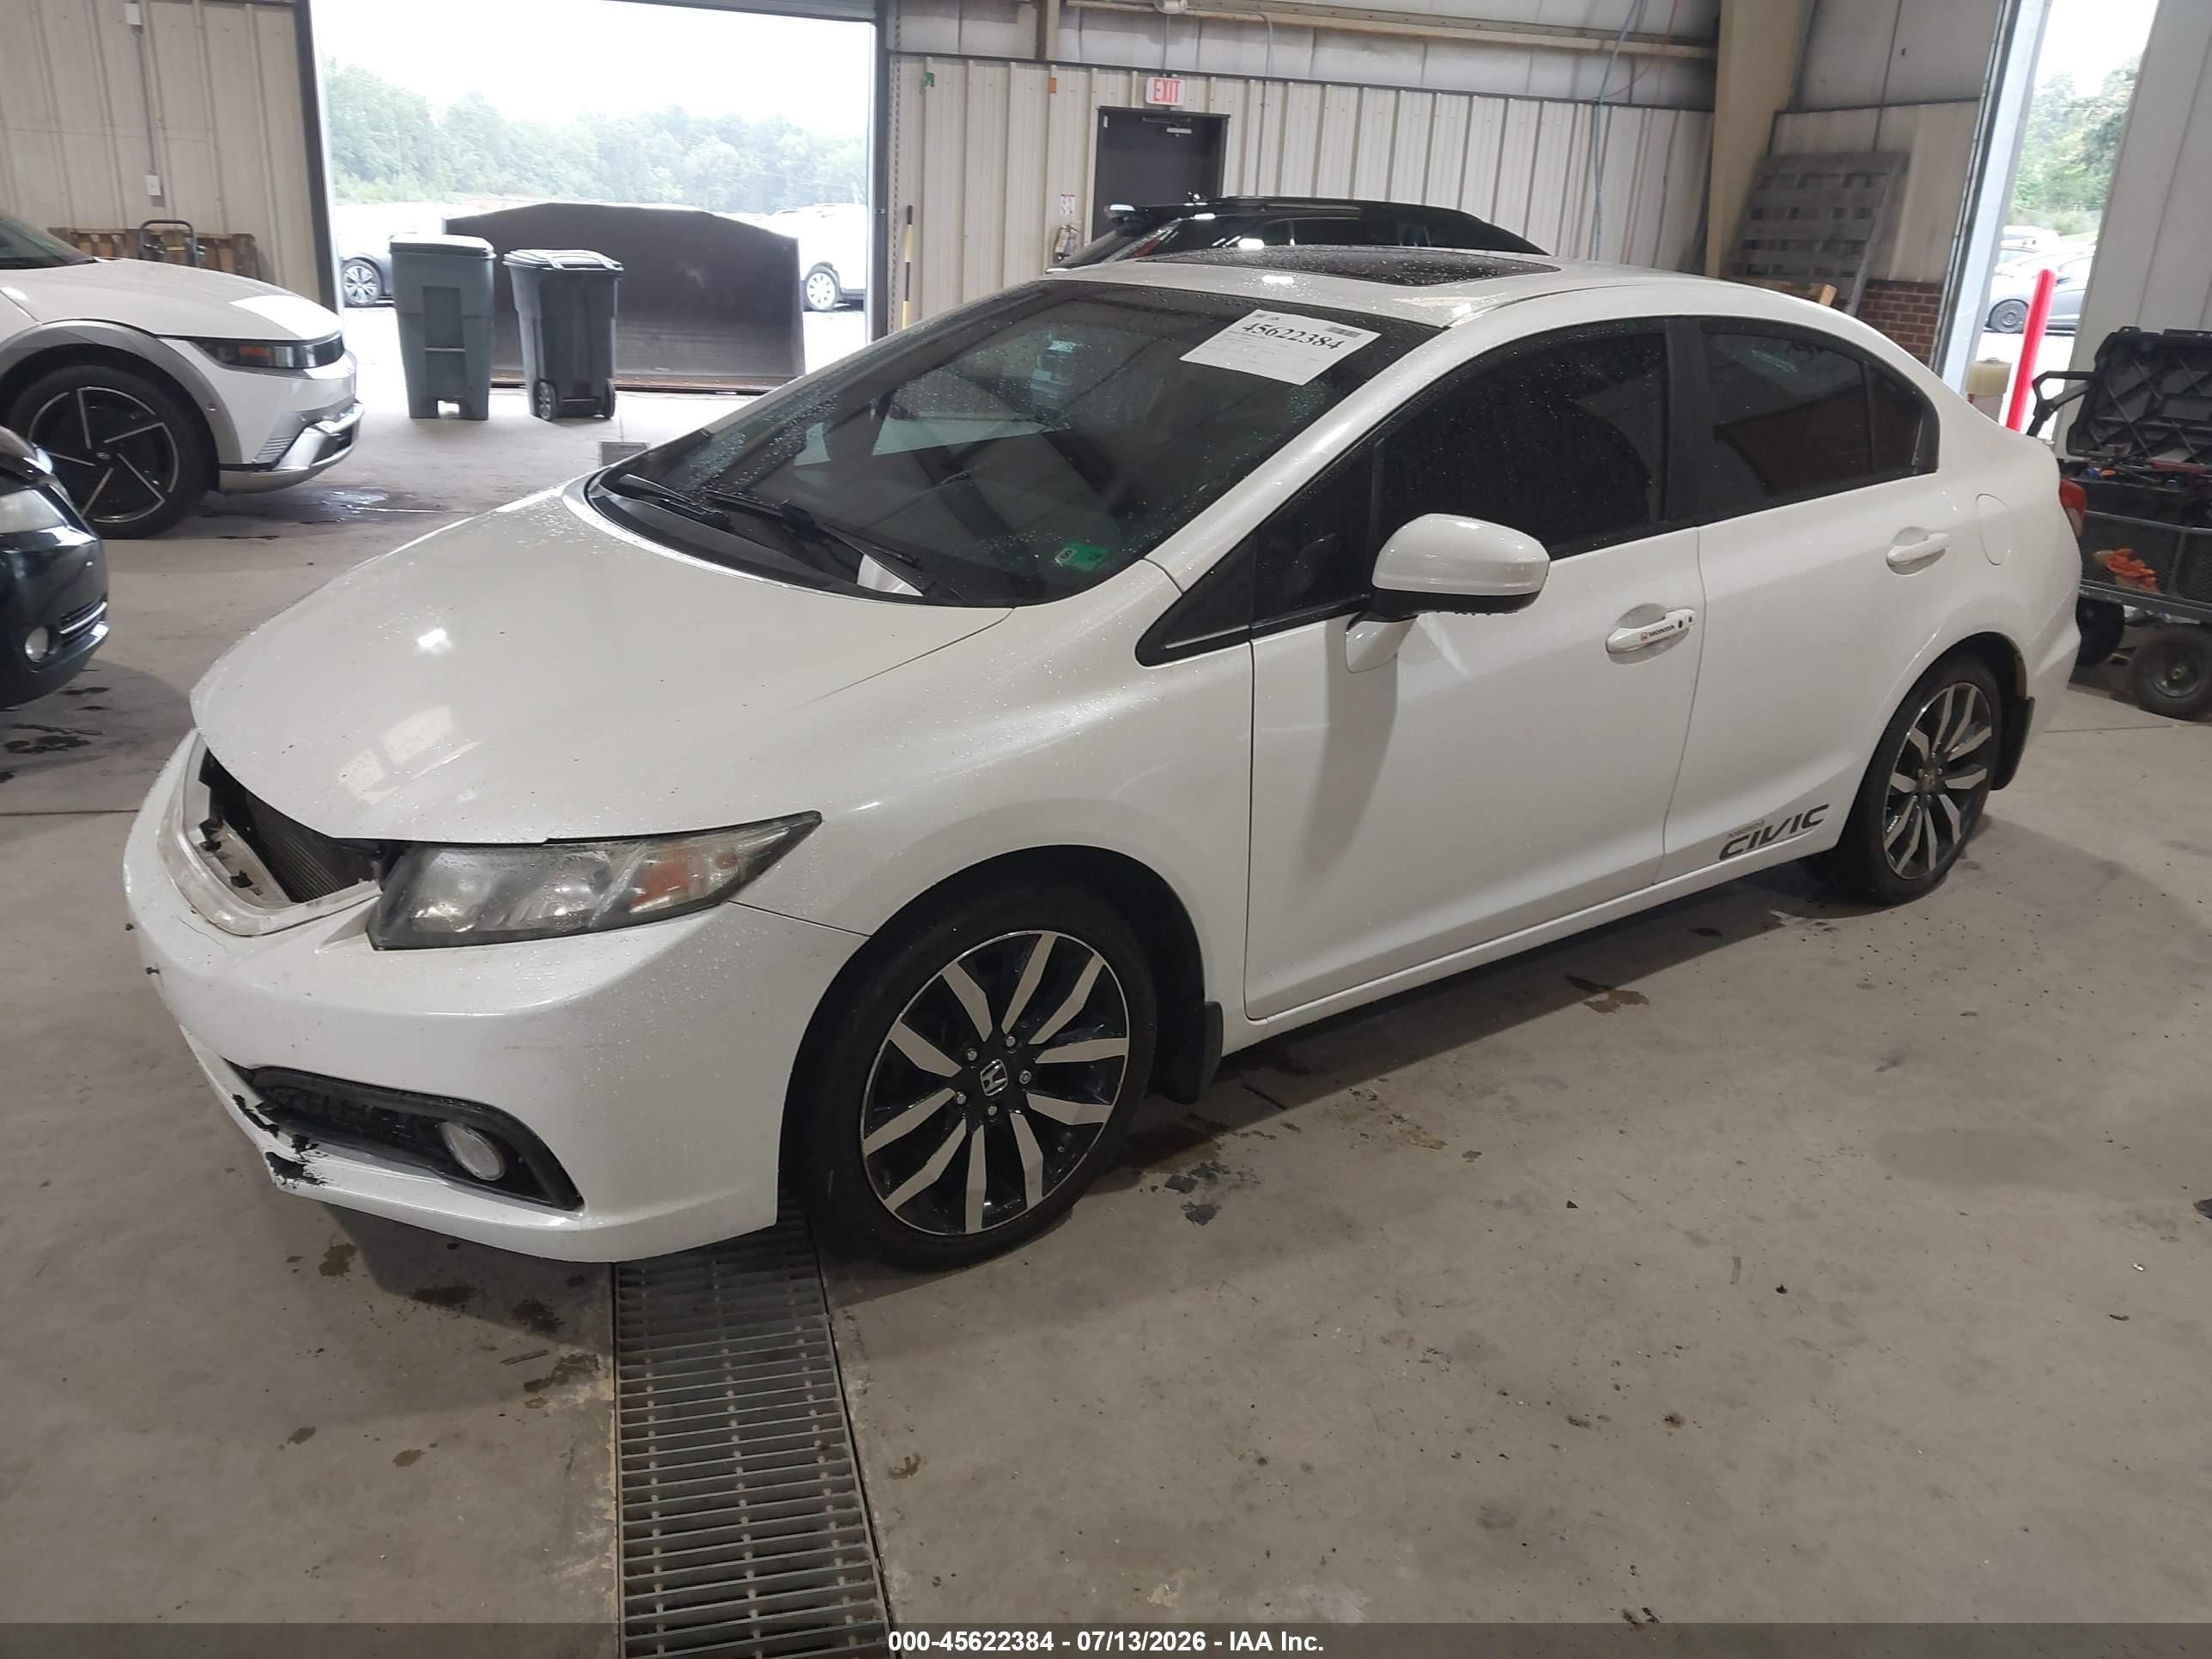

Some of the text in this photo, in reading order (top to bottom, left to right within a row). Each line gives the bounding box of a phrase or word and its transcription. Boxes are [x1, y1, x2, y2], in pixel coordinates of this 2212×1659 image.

[1154, 79, 1181, 103] EXIT
[1242, 322, 1346, 350] 45622384
[1649, 625, 1675, 636] HONDA
[1718, 804, 1830, 860] CIVIC
